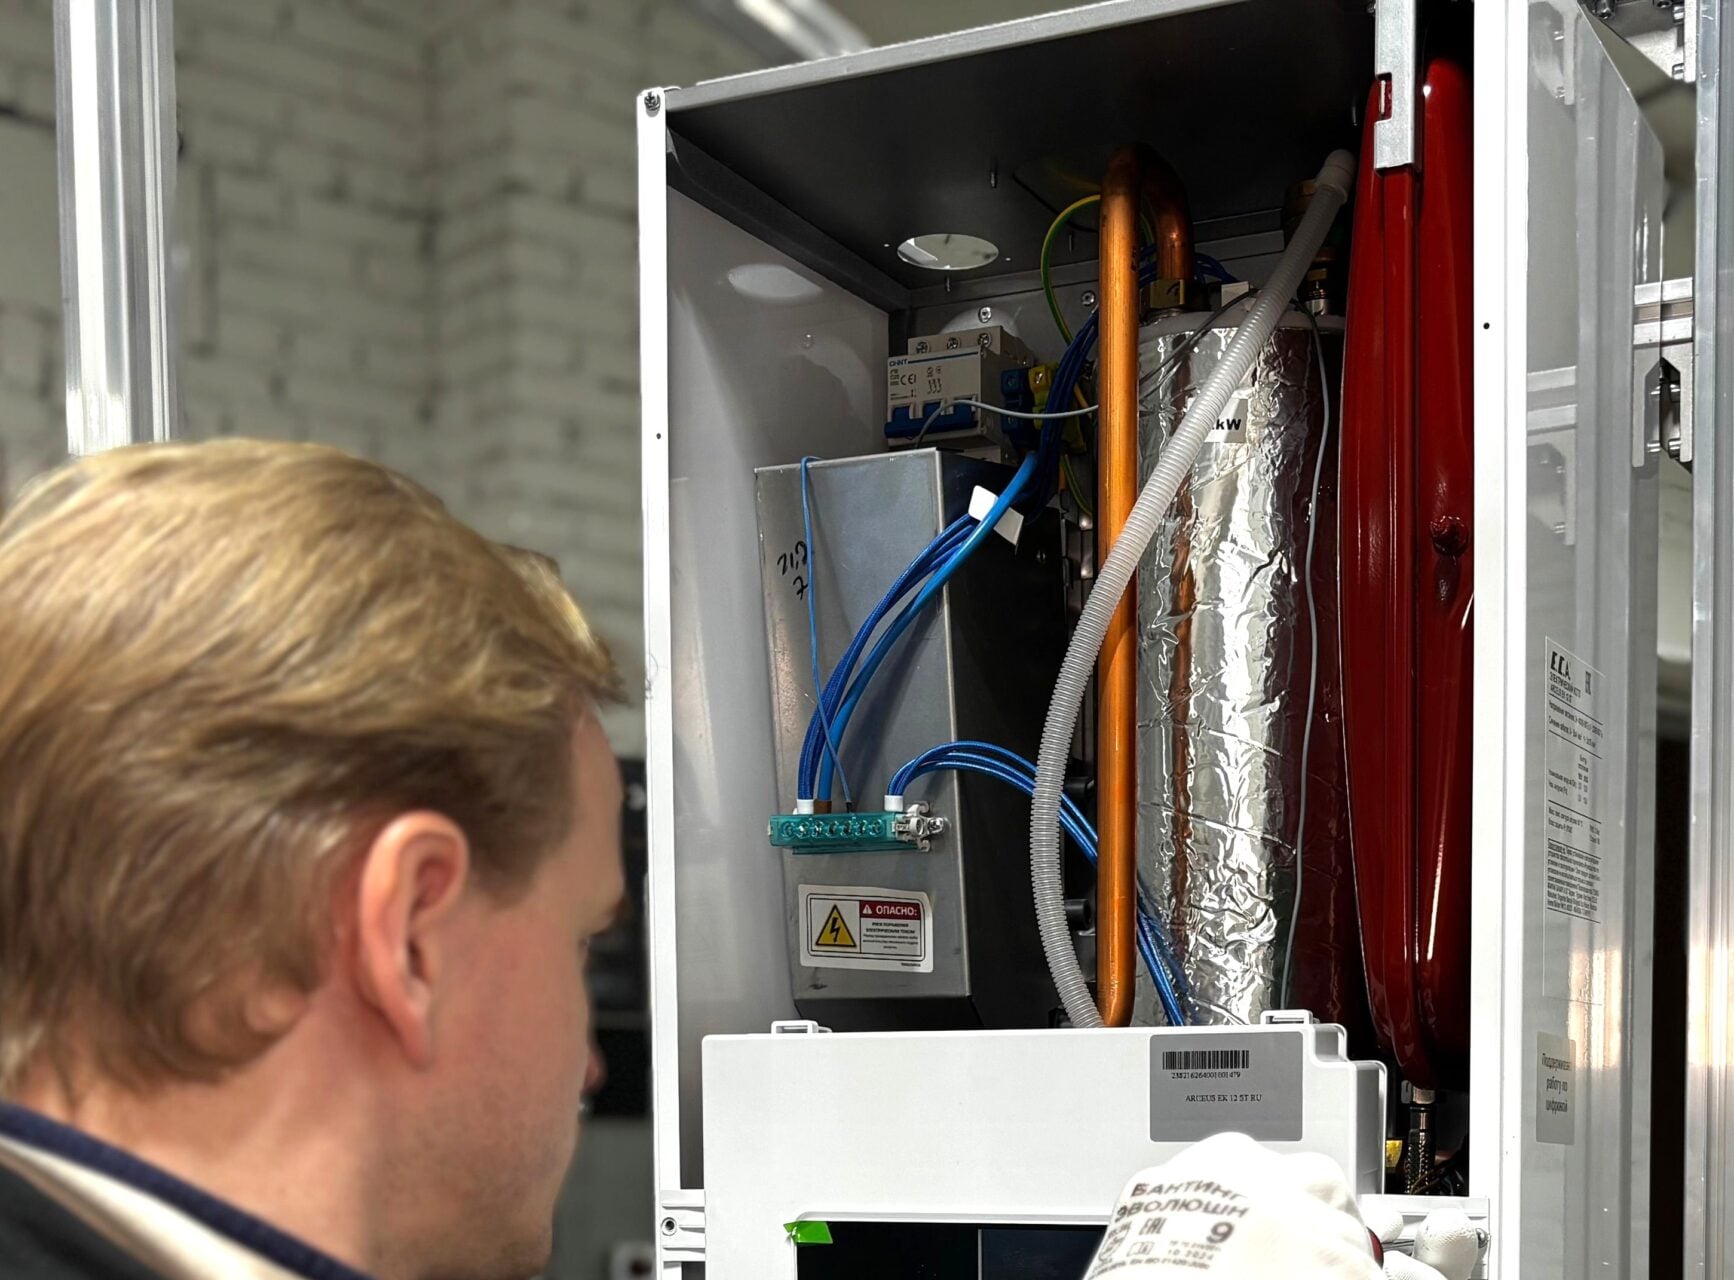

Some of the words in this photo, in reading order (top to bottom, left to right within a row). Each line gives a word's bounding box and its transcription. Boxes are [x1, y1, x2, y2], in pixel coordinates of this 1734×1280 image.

[1212, 418, 1242, 430] kW
[875, 905, 918, 917] ОПАСНО:
[1230, 1094, 1238, 1102] 12
[1130, 1180, 1248, 1201] БАНТИНГ
[1205, 1220, 1235, 1244] 9
